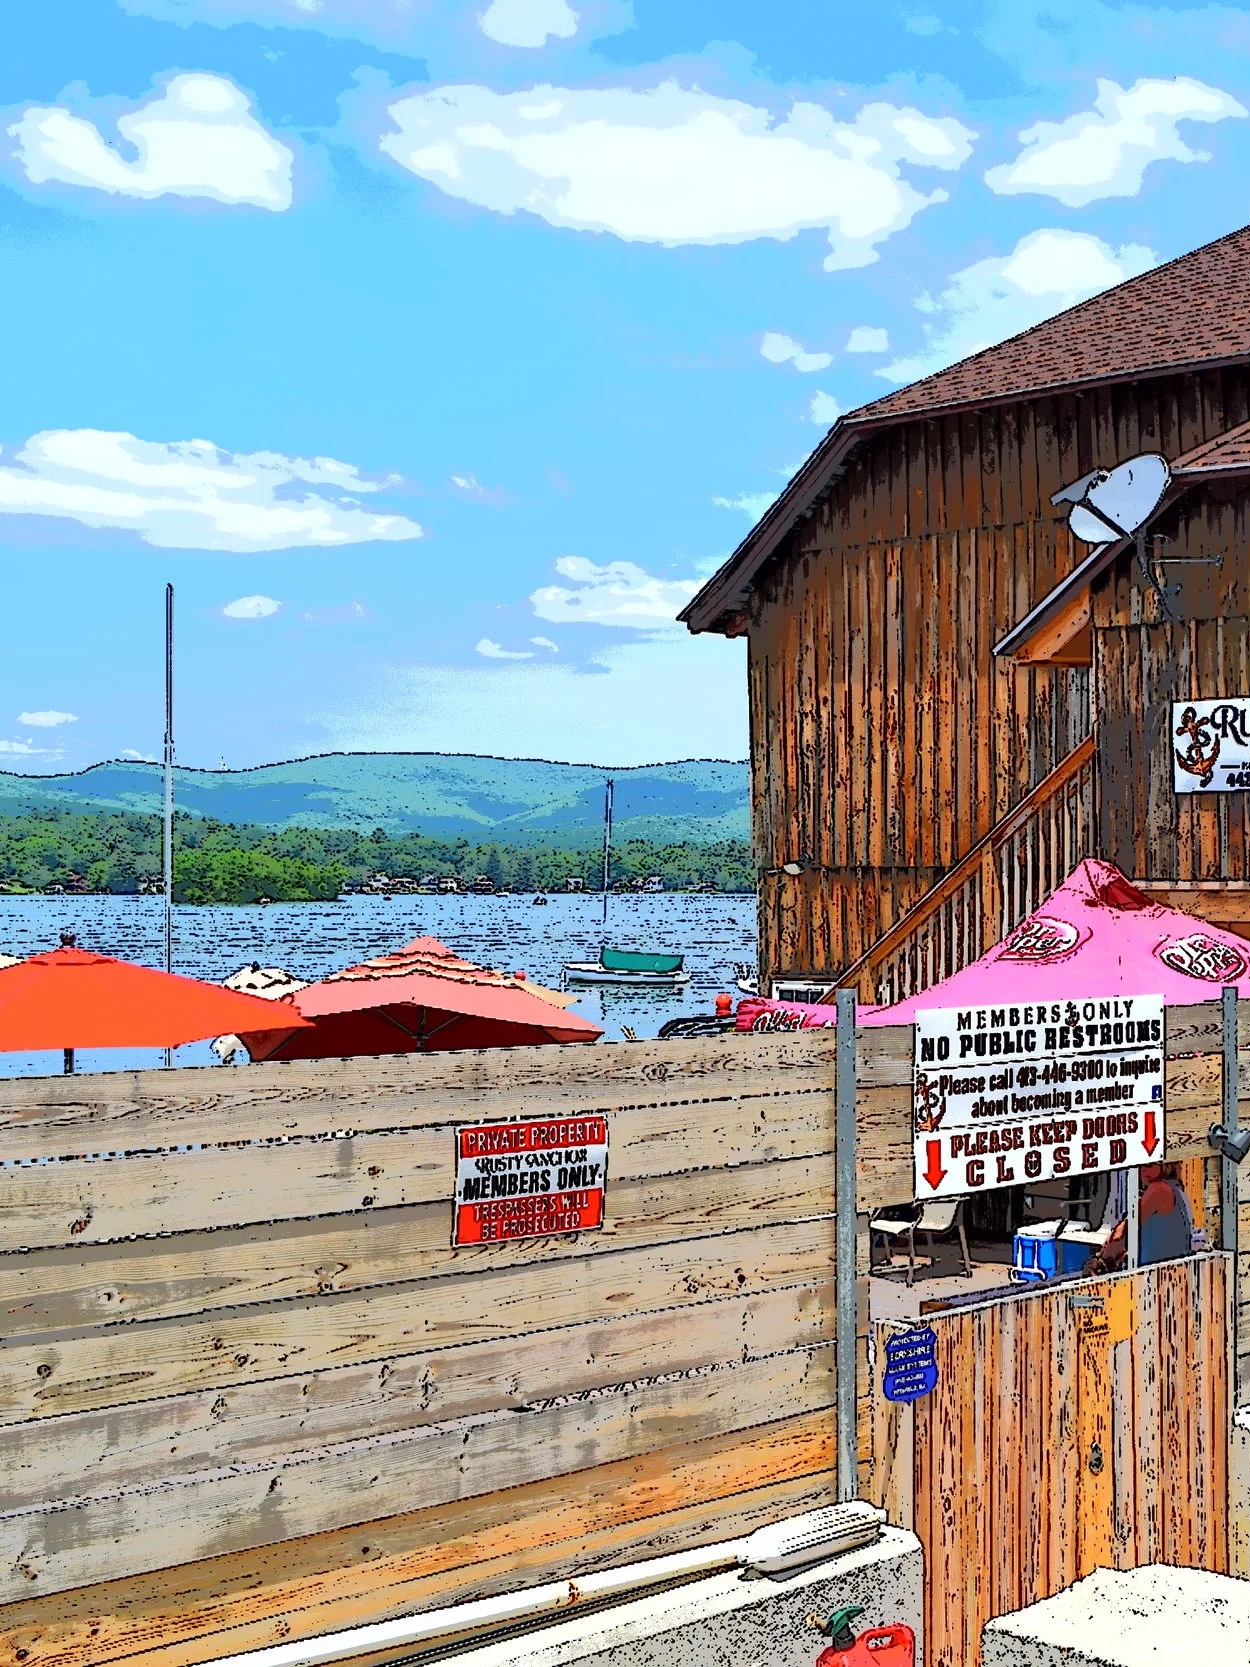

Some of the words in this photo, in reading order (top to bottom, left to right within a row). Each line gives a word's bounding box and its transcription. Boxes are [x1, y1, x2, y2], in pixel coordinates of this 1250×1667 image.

[957, 1004, 1061, 1031] MEMBERS
[1082, 1000, 1134, 1021] ONLY
[920, 1036, 950, 1062] NO
[959, 1029, 1037, 1058] PUBLIC
[1044, 1019, 1161, 1053] RESTROOMS
[939, 1074, 986, 1097] Please
[989, 1067, 1014, 1090] call
[1106, 1062, 1118, 1079] to
[971, 1096, 1008, 1118] about
[1011, 1088, 1072, 1113] becoming
[1075, 1090, 1084, 1105] a
[1086, 1083, 1135, 1105] member
[468, 1128, 526, 1152] PRIVATE
[531, 1121, 600, 1146] PROPERTY
[950, 1131, 1024, 1159] PLEASE
[1028, 1121, 1078, 1147] KEEP
[1082, 1111, 1138, 1138] DOORS
[463, 1169, 551, 1201] MEMBERS
[557, 1163, 601, 1191] ONLY
[474, 1196, 557, 1222] TRESPASSERS
[561, 1192, 590, 1210] WILL
[482, 1222, 498, 1239] BE
[502, 1212, 580, 1237] PROSECUTED
